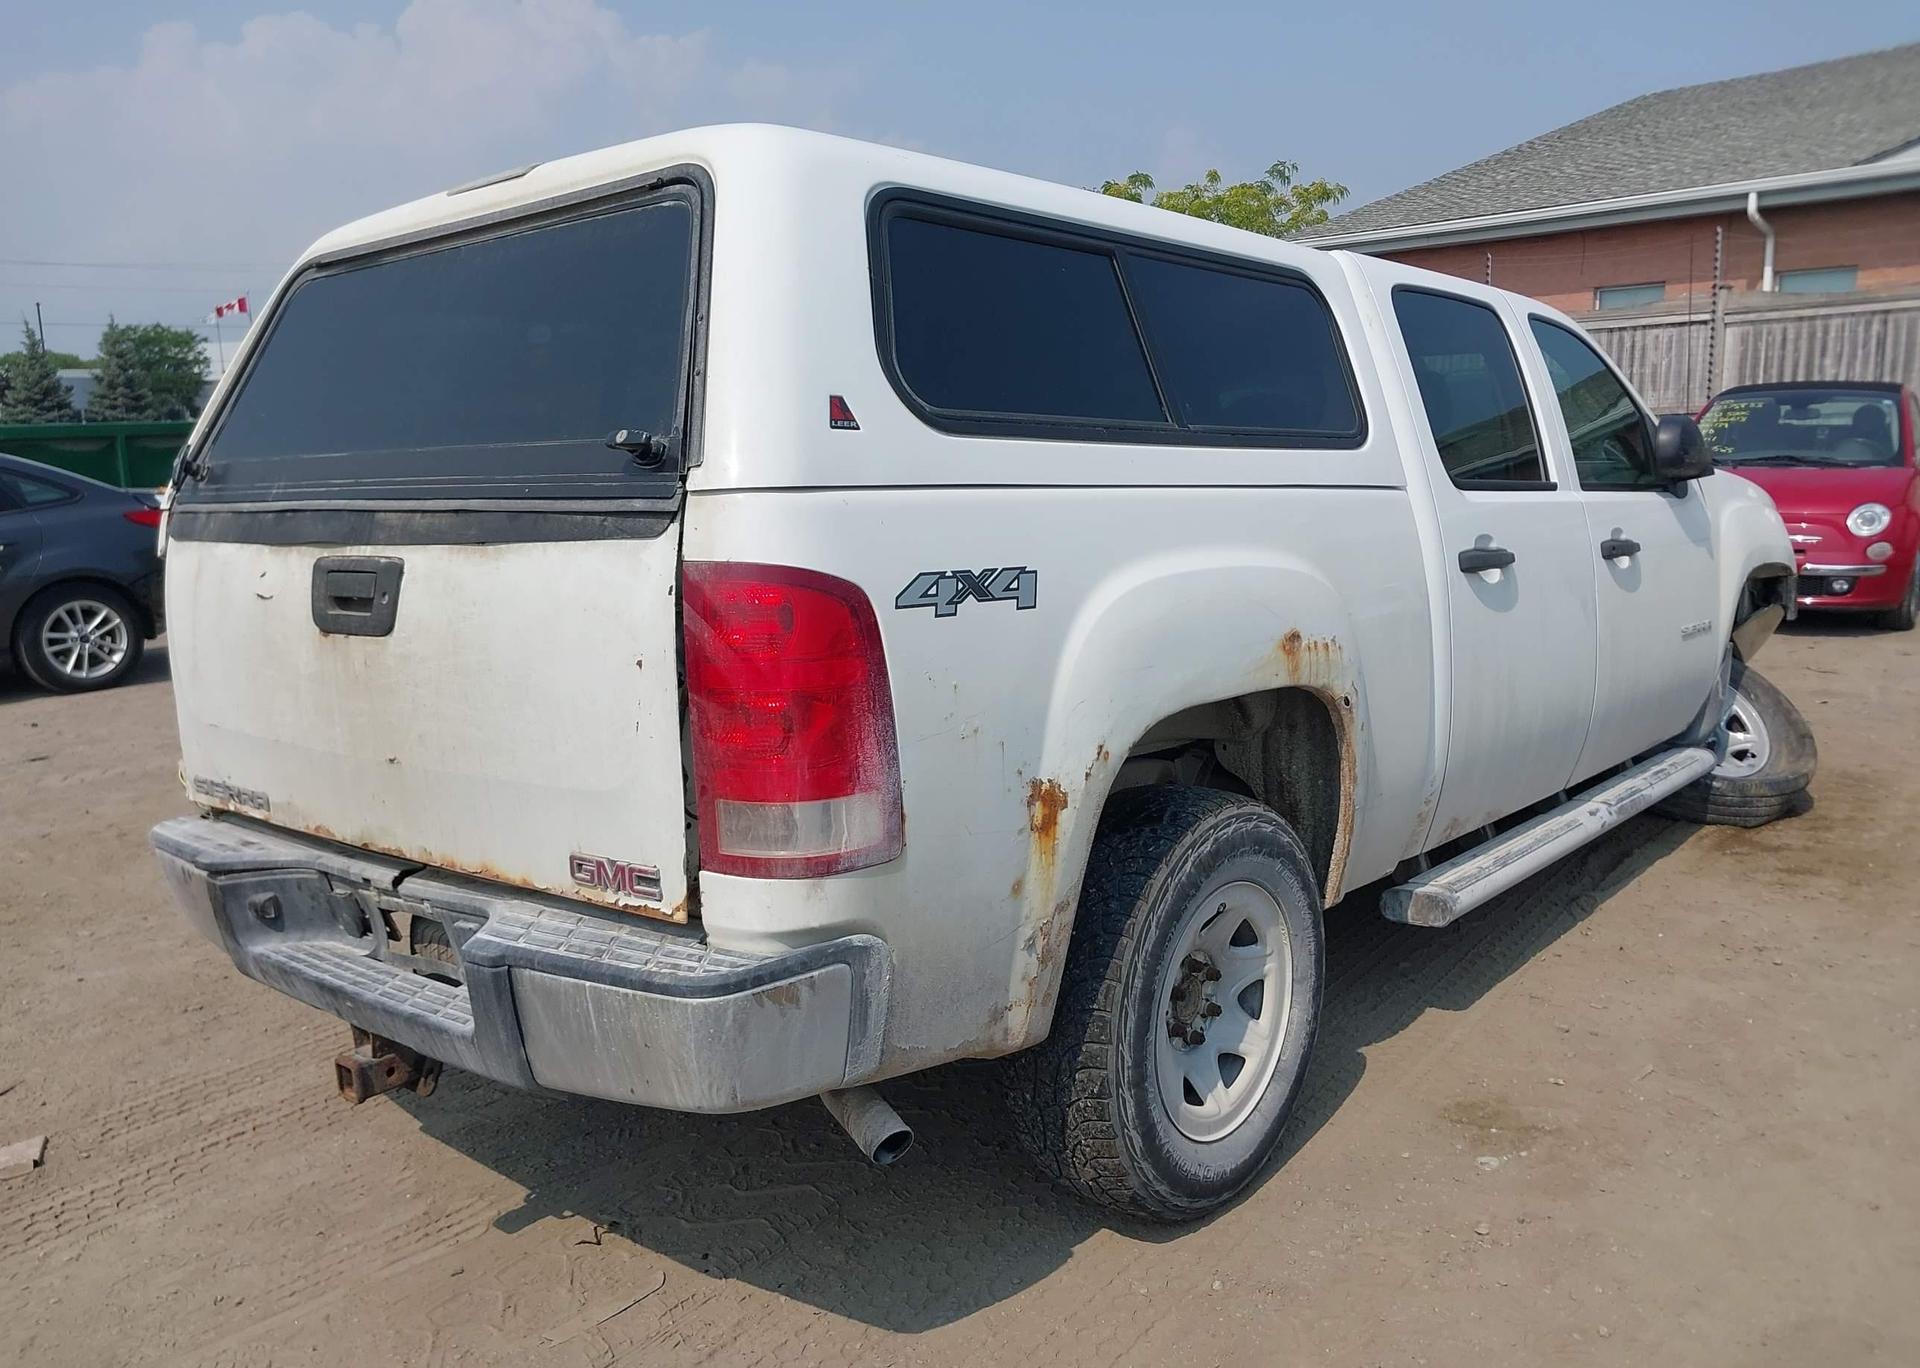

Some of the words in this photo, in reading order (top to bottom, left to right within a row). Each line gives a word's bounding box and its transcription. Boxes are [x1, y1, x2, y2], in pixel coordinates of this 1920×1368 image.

[831, 420, 858, 428] LEER
[194, 775, 271, 812] SIERRA
[569, 853, 663, 902] GMC
